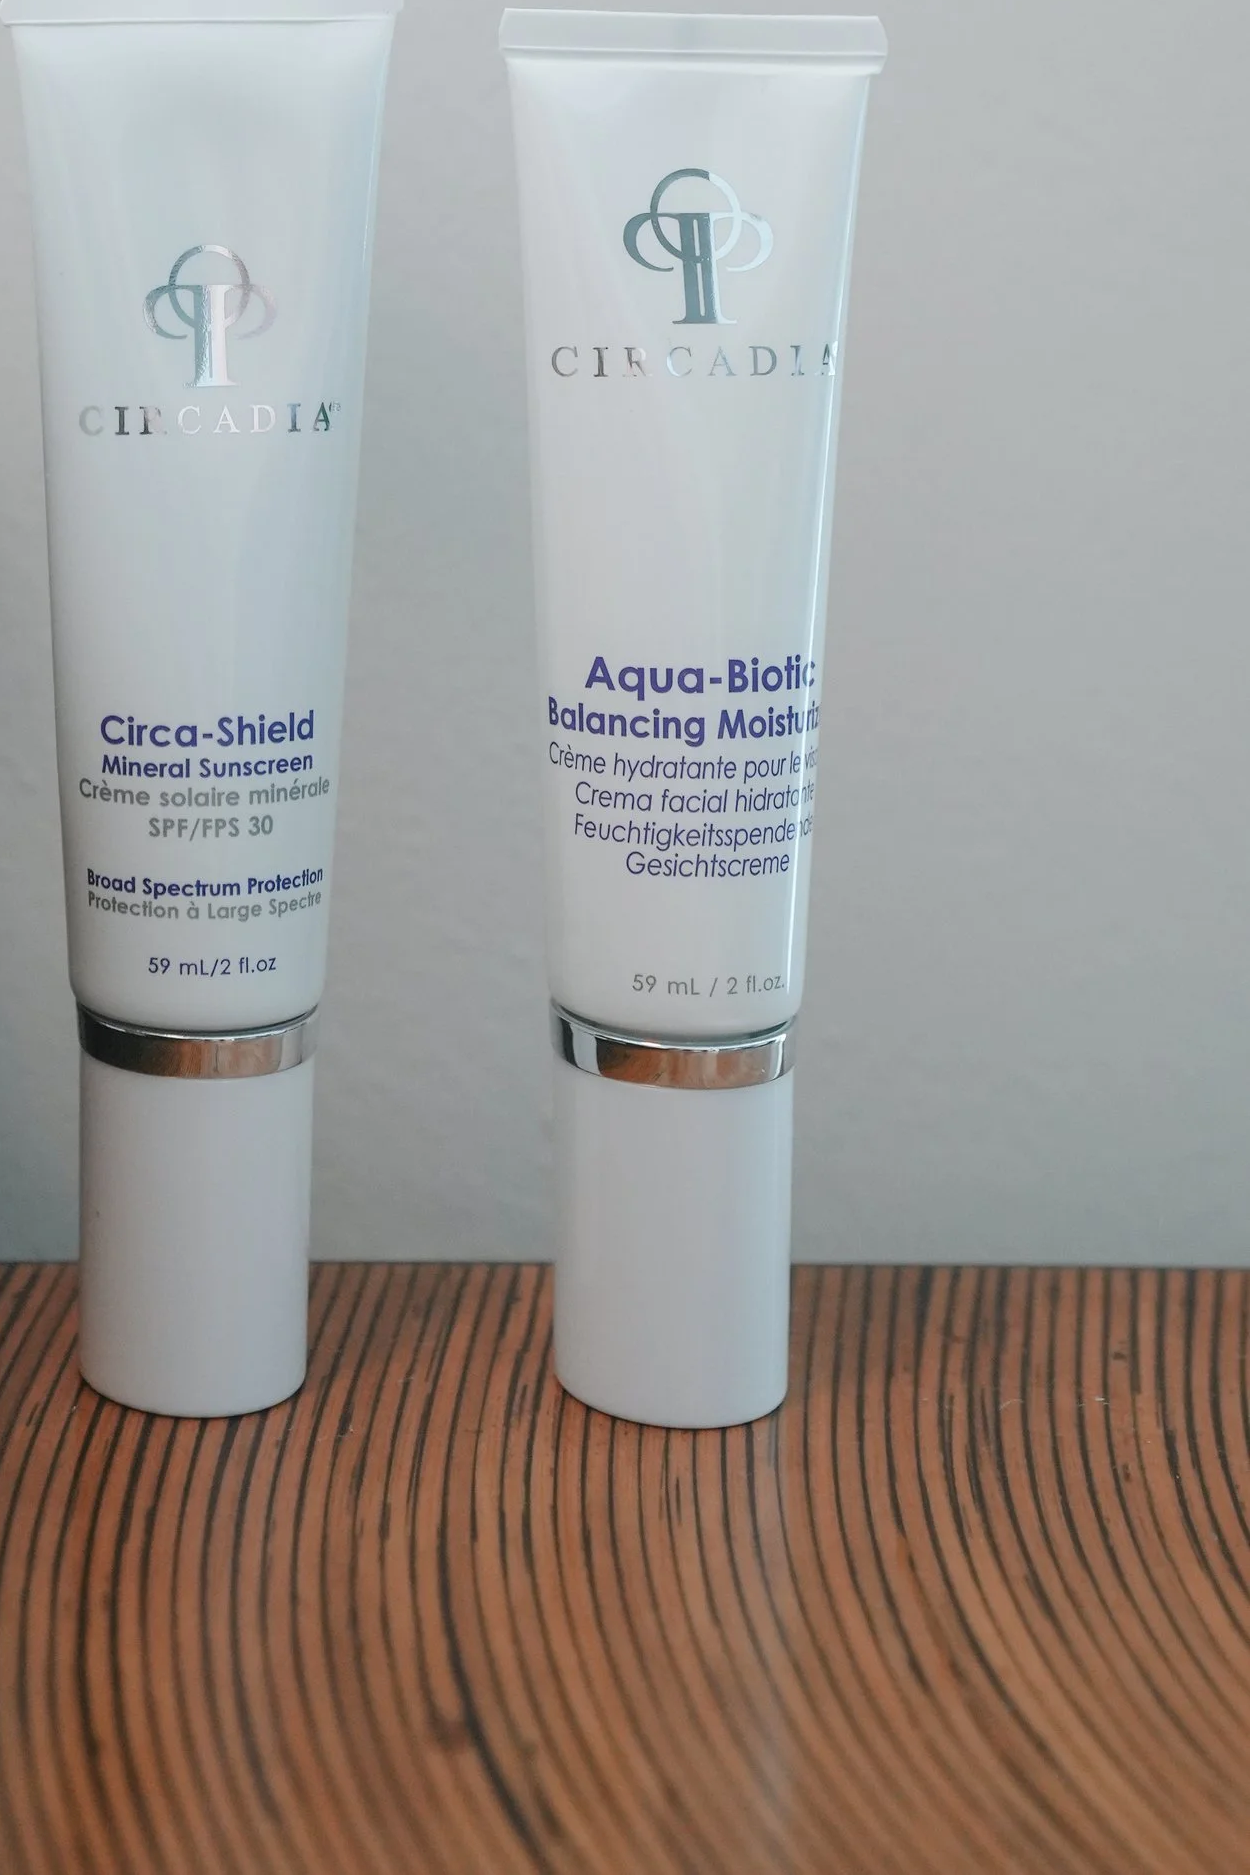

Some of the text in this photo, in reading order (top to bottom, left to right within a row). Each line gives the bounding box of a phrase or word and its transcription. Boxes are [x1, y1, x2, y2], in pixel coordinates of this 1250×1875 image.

[585, 654, 816, 701] Aqua-Biotic
[100, 709, 314, 747] Circa-Shield
[548, 696, 705, 747] Balancing
[101, 754, 313, 778] Mineral Sunscreen
[549, 741, 606, 774] Crème
[613, 752, 737, 782] hydratante
[743, 757, 787, 784] pour
[789, 749, 801, 774] le
[79, 776, 330, 807] Crème solaire minérale
[575, 781, 652, 812] Crema
[661, 788, 728, 813] facial
[148, 814, 274, 842] SPF/FPS 30
[625, 851, 790, 877] Gesichtscreme
[87, 867, 323, 900] Broad Spectrum Protection
[88, 890, 322, 922] Protection à Large Spectre
[148, 957, 170, 974] 59
[179, 958, 231, 977] mL/2
[632, 974, 657, 992] 59
[667, 977, 700, 996] mL
[709, 977, 719, 998] /
[726, 977, 738, 994] 2
